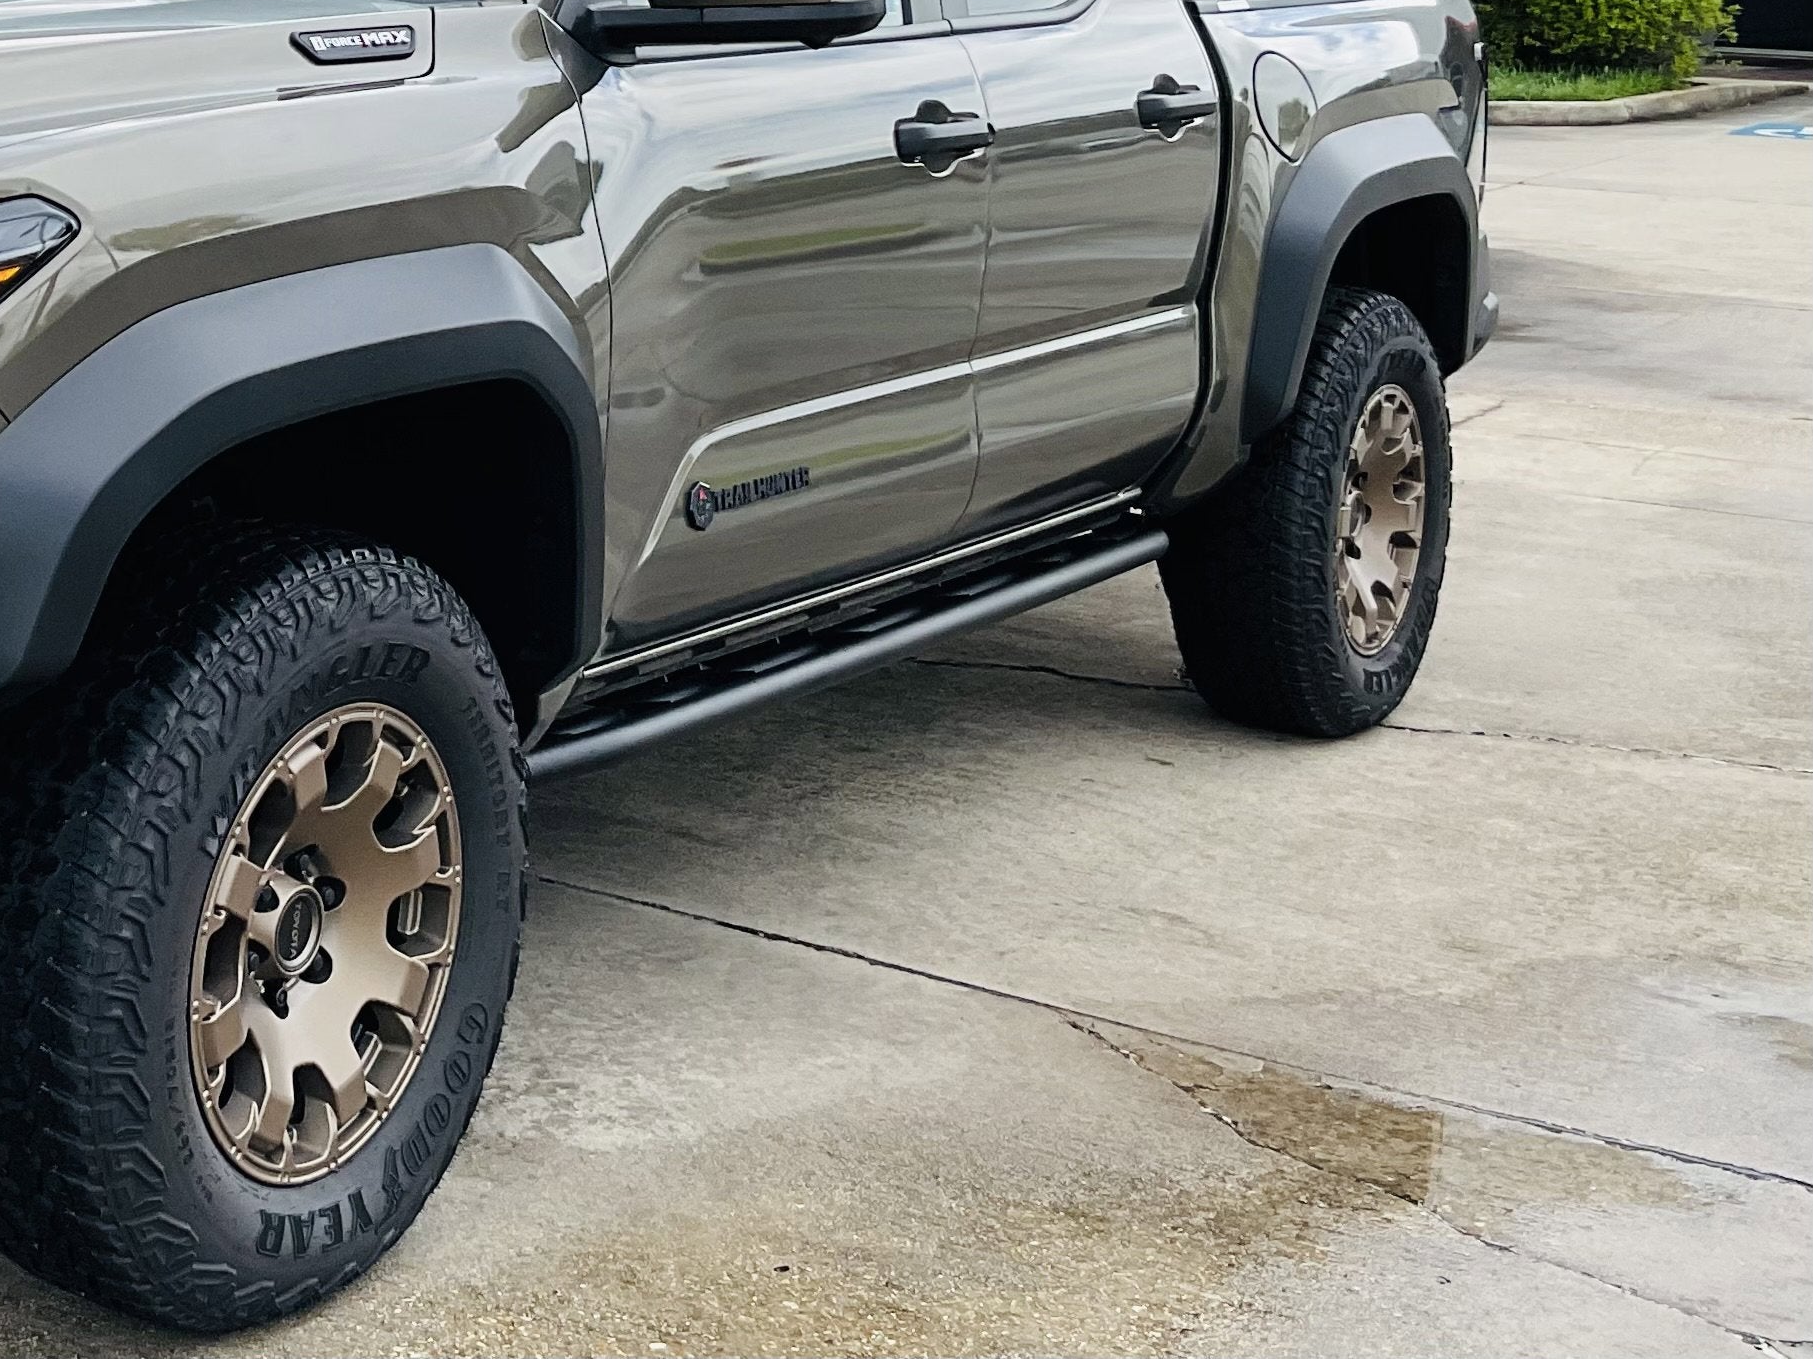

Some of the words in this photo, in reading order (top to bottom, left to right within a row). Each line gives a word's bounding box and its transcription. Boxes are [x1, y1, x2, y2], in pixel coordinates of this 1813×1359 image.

[361, 30, 410, 46] MAX
[713, 467, 811, 512] TRAILHUNTER
[289, 902, 303, 959] TOYOTA
[255, 1002, 488, 1260] GOODYEAR
